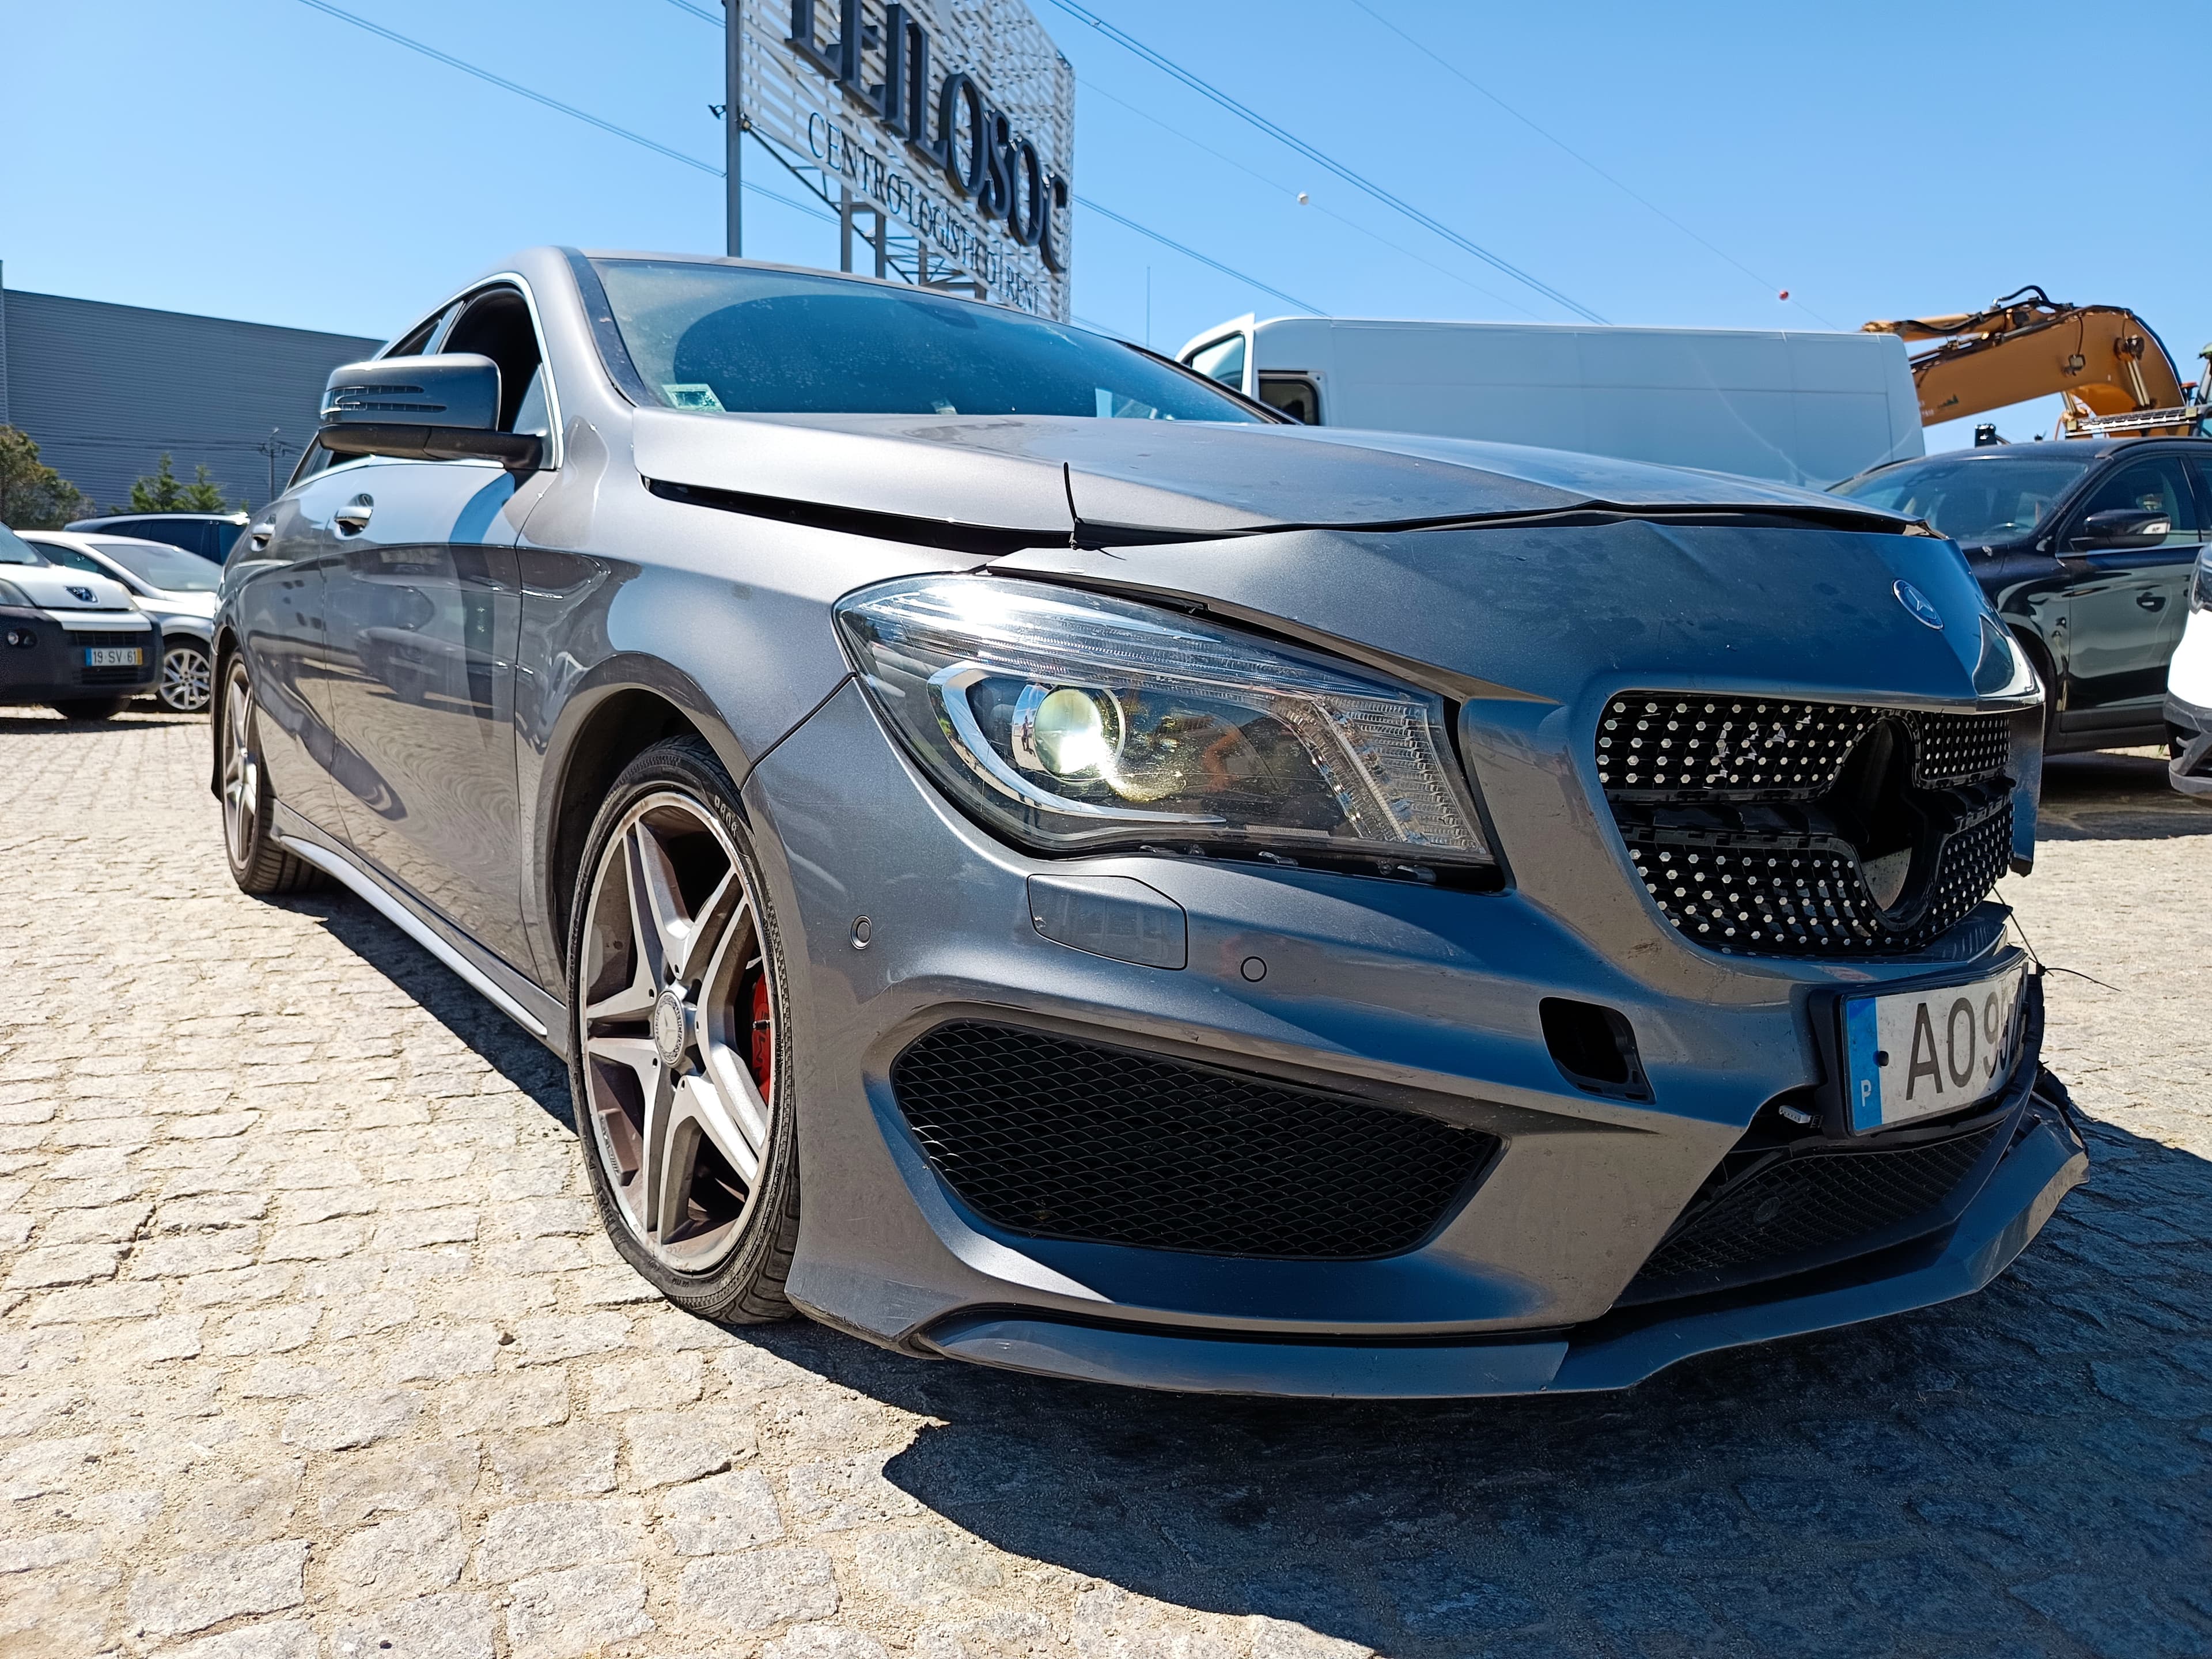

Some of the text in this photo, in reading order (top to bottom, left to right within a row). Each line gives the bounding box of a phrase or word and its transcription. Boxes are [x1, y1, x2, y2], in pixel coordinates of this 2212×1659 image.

[809, 112, 901, 214] CENTRO
[94, 650, 103, 664] 19
[108, 650, 122, 664] SV
[1861, 1079, 1872, 1107] P
